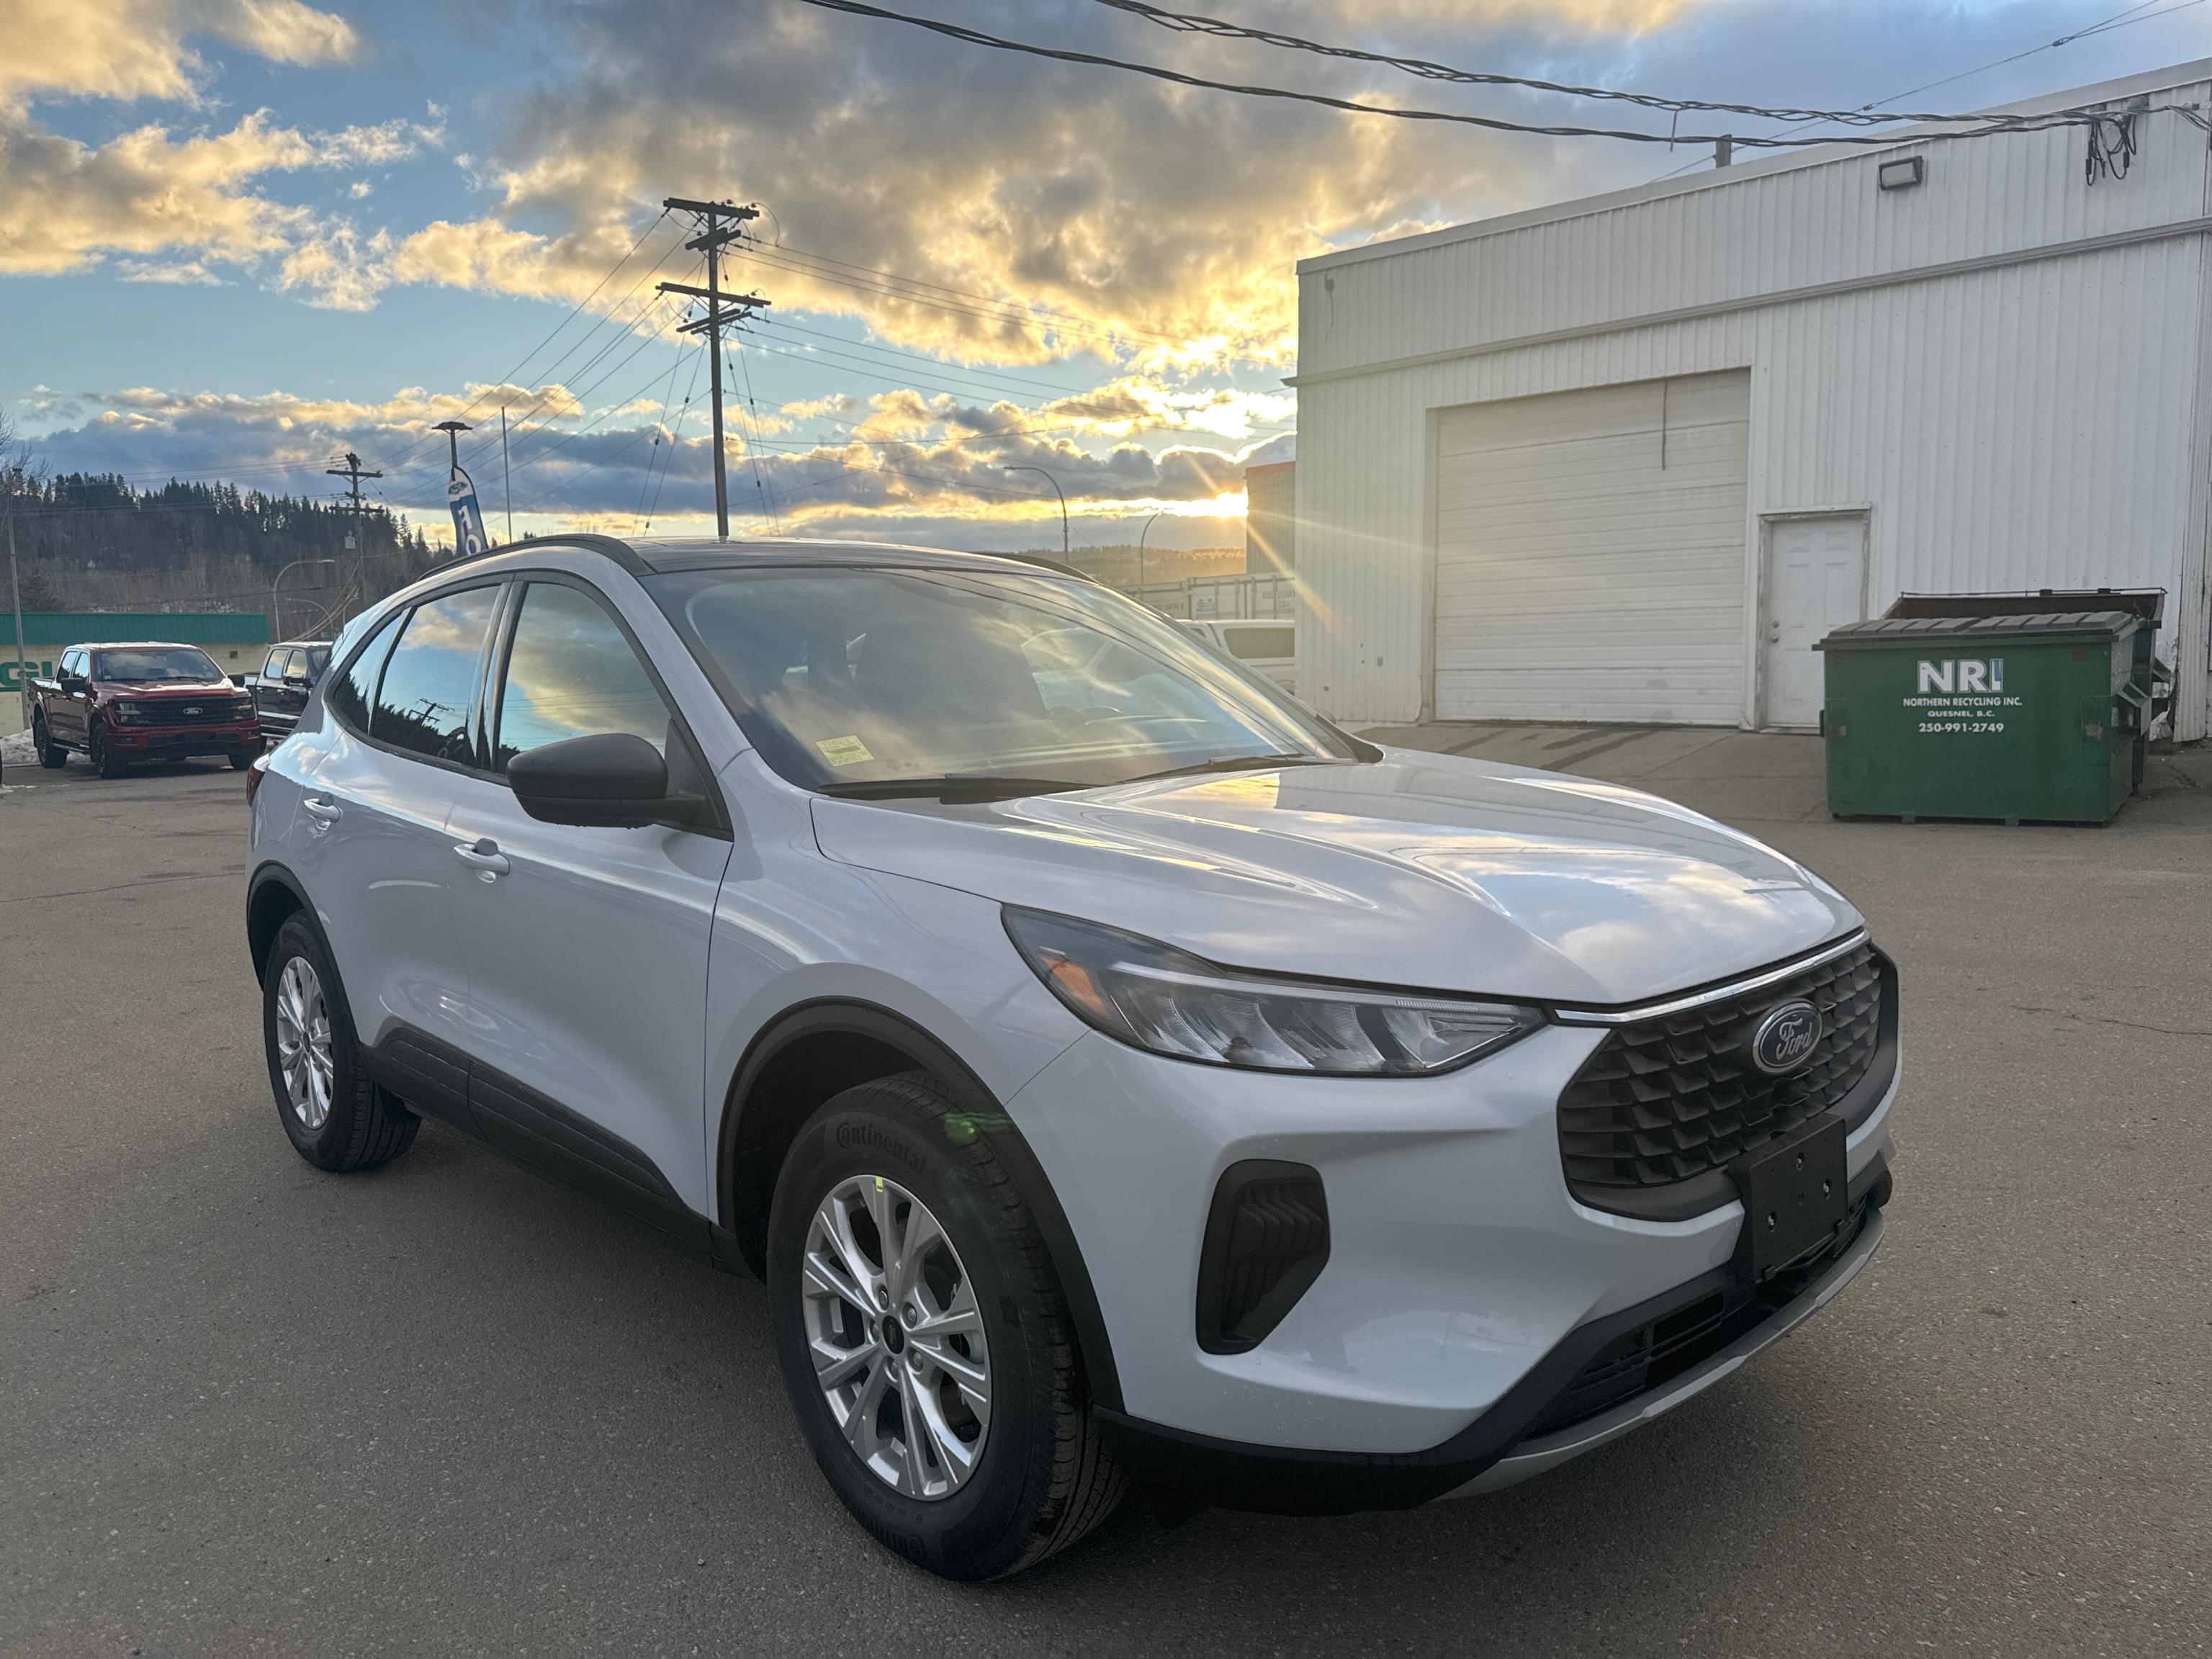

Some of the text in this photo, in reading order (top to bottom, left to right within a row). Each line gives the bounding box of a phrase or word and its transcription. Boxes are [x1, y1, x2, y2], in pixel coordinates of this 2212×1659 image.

[1903, 697, 2022, 706] NORTHERN RECYCLING INC.
[1918, 723, 2004, 732] 250-991-2749
[1776, 1017, 1812, 1060] Ford
[837, 1121, 927, 1177] Continental
